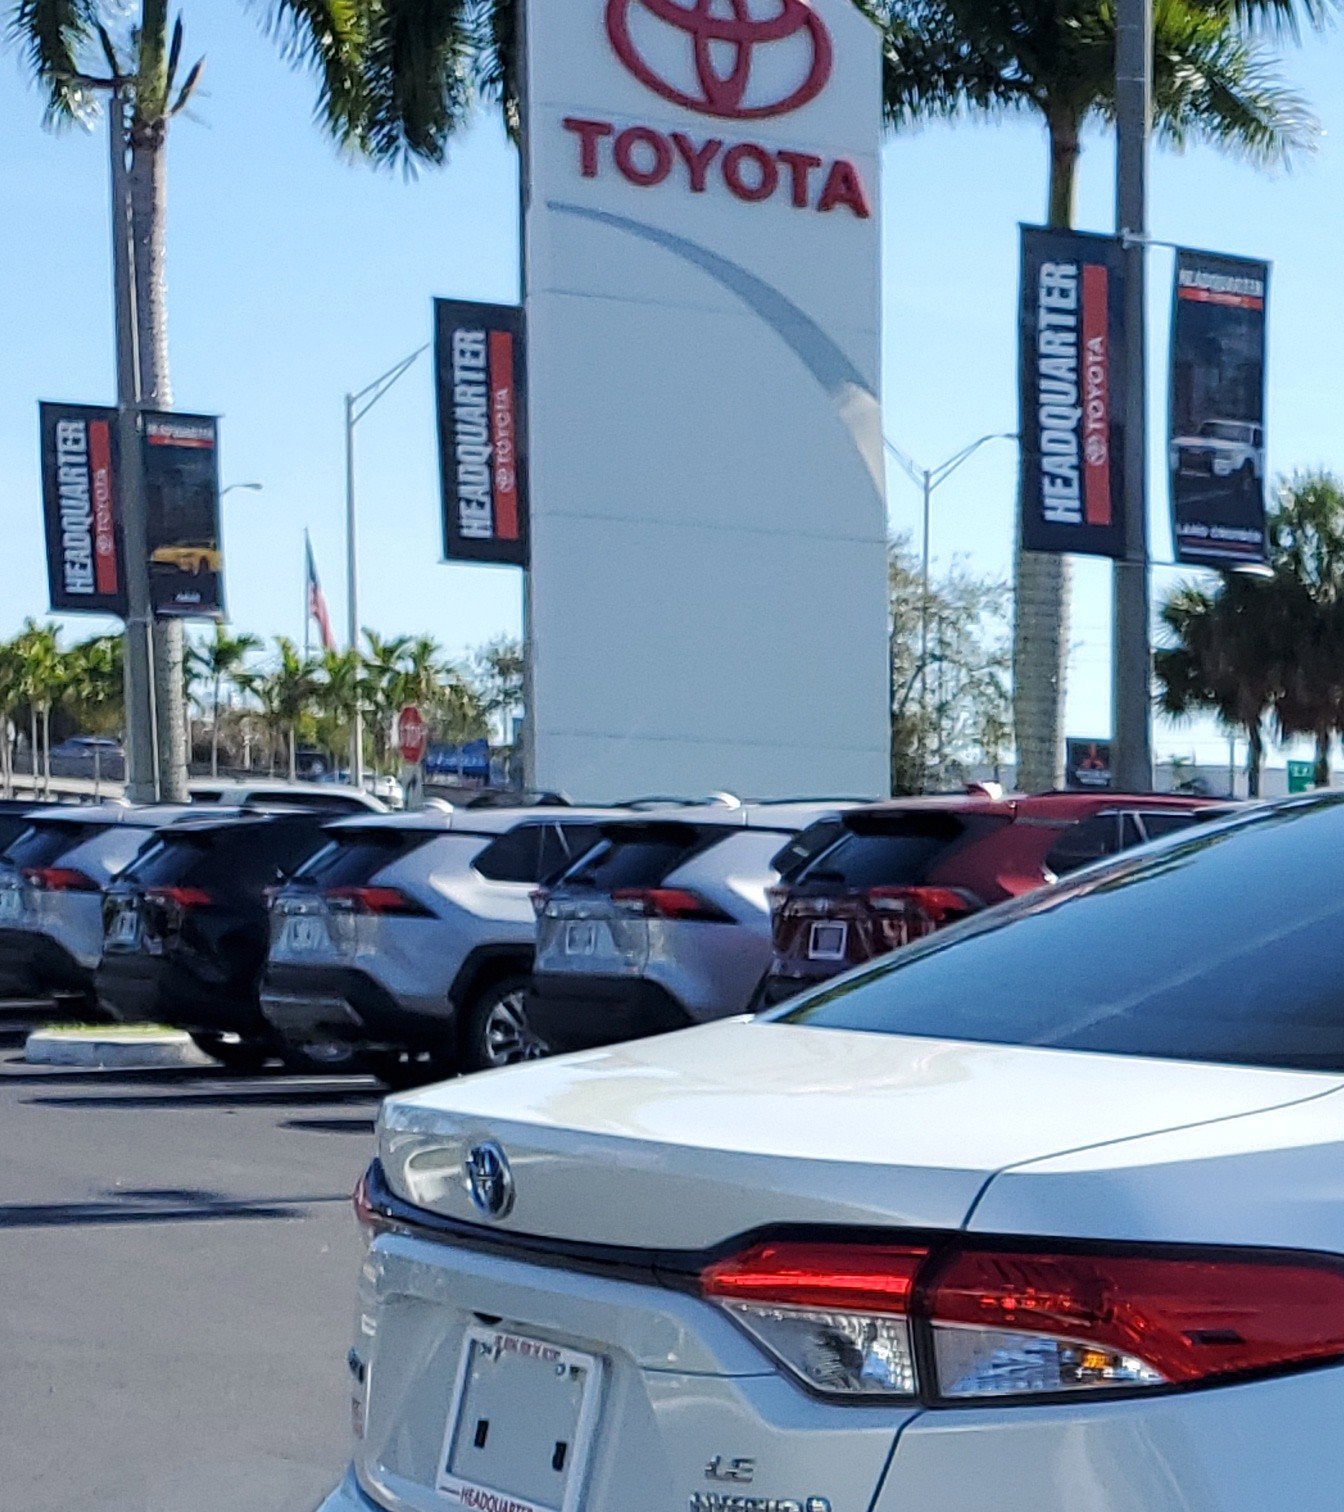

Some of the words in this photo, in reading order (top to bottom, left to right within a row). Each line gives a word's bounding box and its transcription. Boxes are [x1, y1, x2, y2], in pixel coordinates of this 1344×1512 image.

[561, 116, 870, 219] TOYOTA
[453, 328, 493, 539] HEADQUARTER
[494, 388, 512, 463] TOYOTA
[1039, 261, 1083, 524] HEADQUARTER
[1086, 336, 1105, 432] TOYOTA
[56, 419, 95, 594] HEADQUARTER
[92, 468, 112, 531] TOYOTA
[704, 1455, 755, 1483] LE
